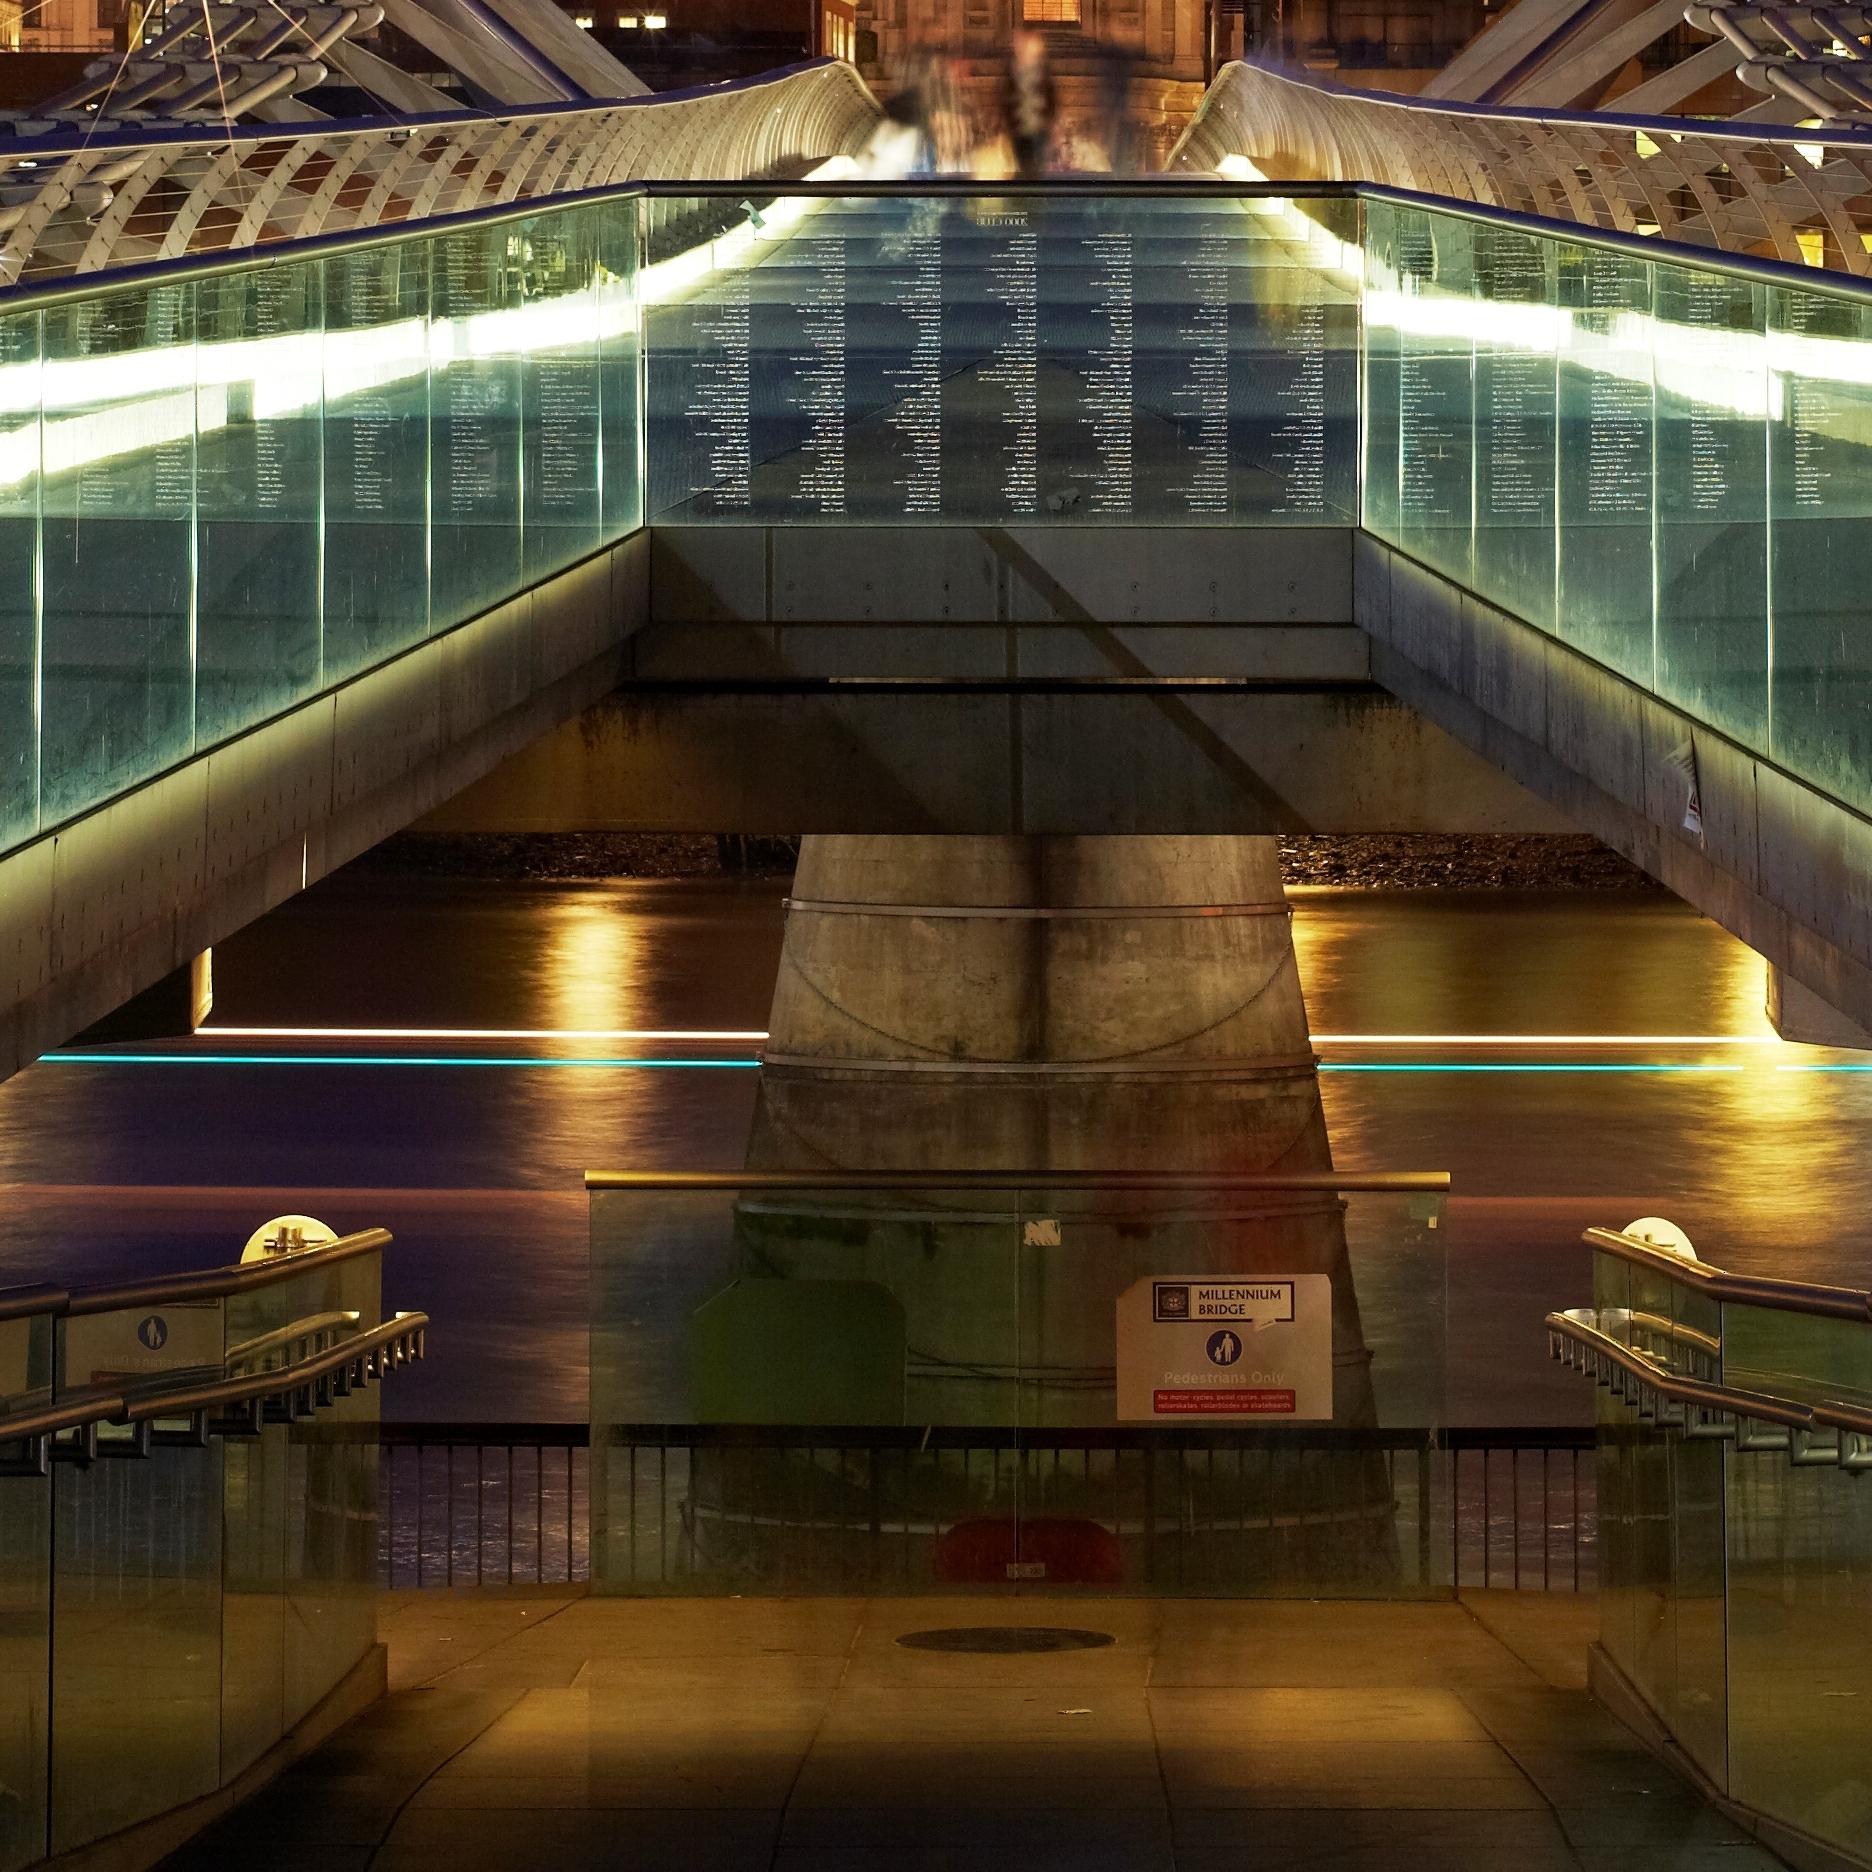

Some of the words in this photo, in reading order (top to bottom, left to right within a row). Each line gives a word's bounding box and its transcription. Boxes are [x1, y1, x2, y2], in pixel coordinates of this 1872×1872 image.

[1198, 1289, 1281, 1300] MILLENNIUM
[1199, 1304, 1246, 1315] BRIDGE
[1164, 1371, 1247, 1384] Pedestrians
[1251, 1371, 1285, 1385] Only
